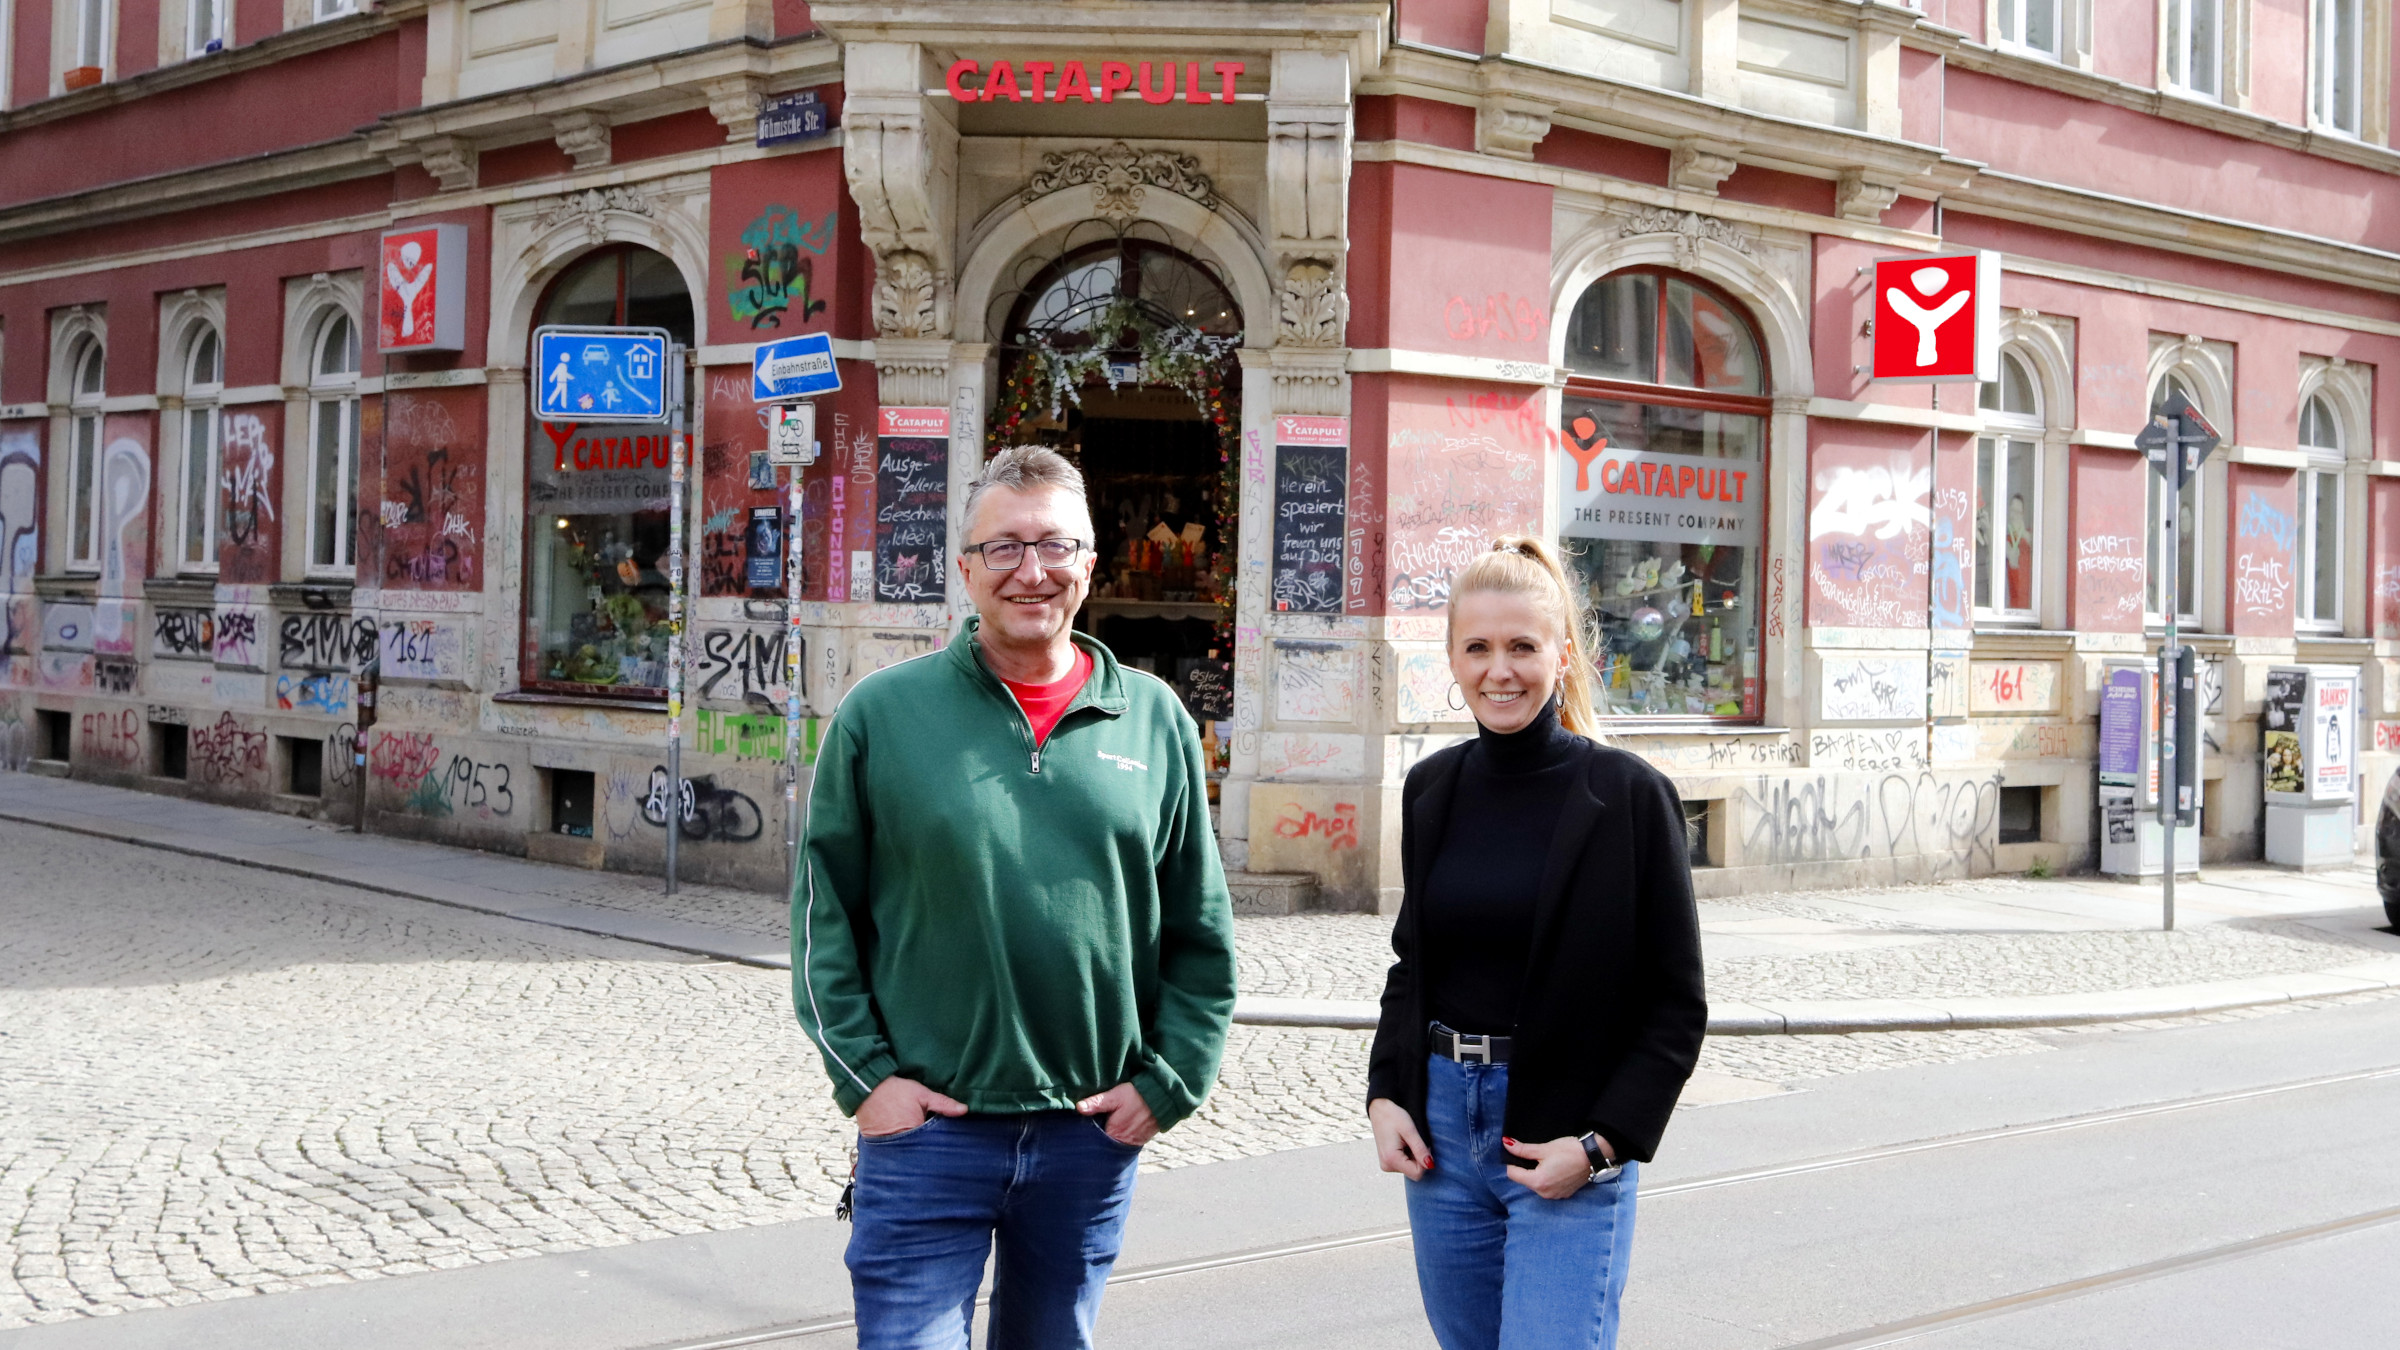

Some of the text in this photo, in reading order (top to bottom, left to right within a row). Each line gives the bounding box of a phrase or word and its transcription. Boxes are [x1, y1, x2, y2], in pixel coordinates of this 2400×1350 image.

[945, 59, 1245, 104] CATAPULT
[758, 110, 820, 140] Böhmische Str.
[771, 357, 829, 377] Einbahnstraße
[897, 418, 944, 427] CATAPULT
[1295, 427, 1342, 437] CATAPULT
[573, 433, 694, 471] CATAPUT
[878, 452, 932, 479] Ausge-
[579, 486, 628, 499] PRESENT
[1280, 475, 1332, 494] Herein
[1601, 458, 1748, 503] CATAPULT
[1280, 498, 1345, 522] spaziert
[1575, 507, 1744, 531] THE PRESENT COMPANY
[1300, 522, 1325, 534] wir
[1320, 536, 1342, 551] uns
[1280, 549, 1341, 569] auf Dich
[389, 620, 434, 664] 161
[1989, 666, 2023, 704] 161
[2320, 688, 2350, 707] BANKSY
[82, 708, 140, 763] ACAB
[445, 754, 513, 815] 1953
